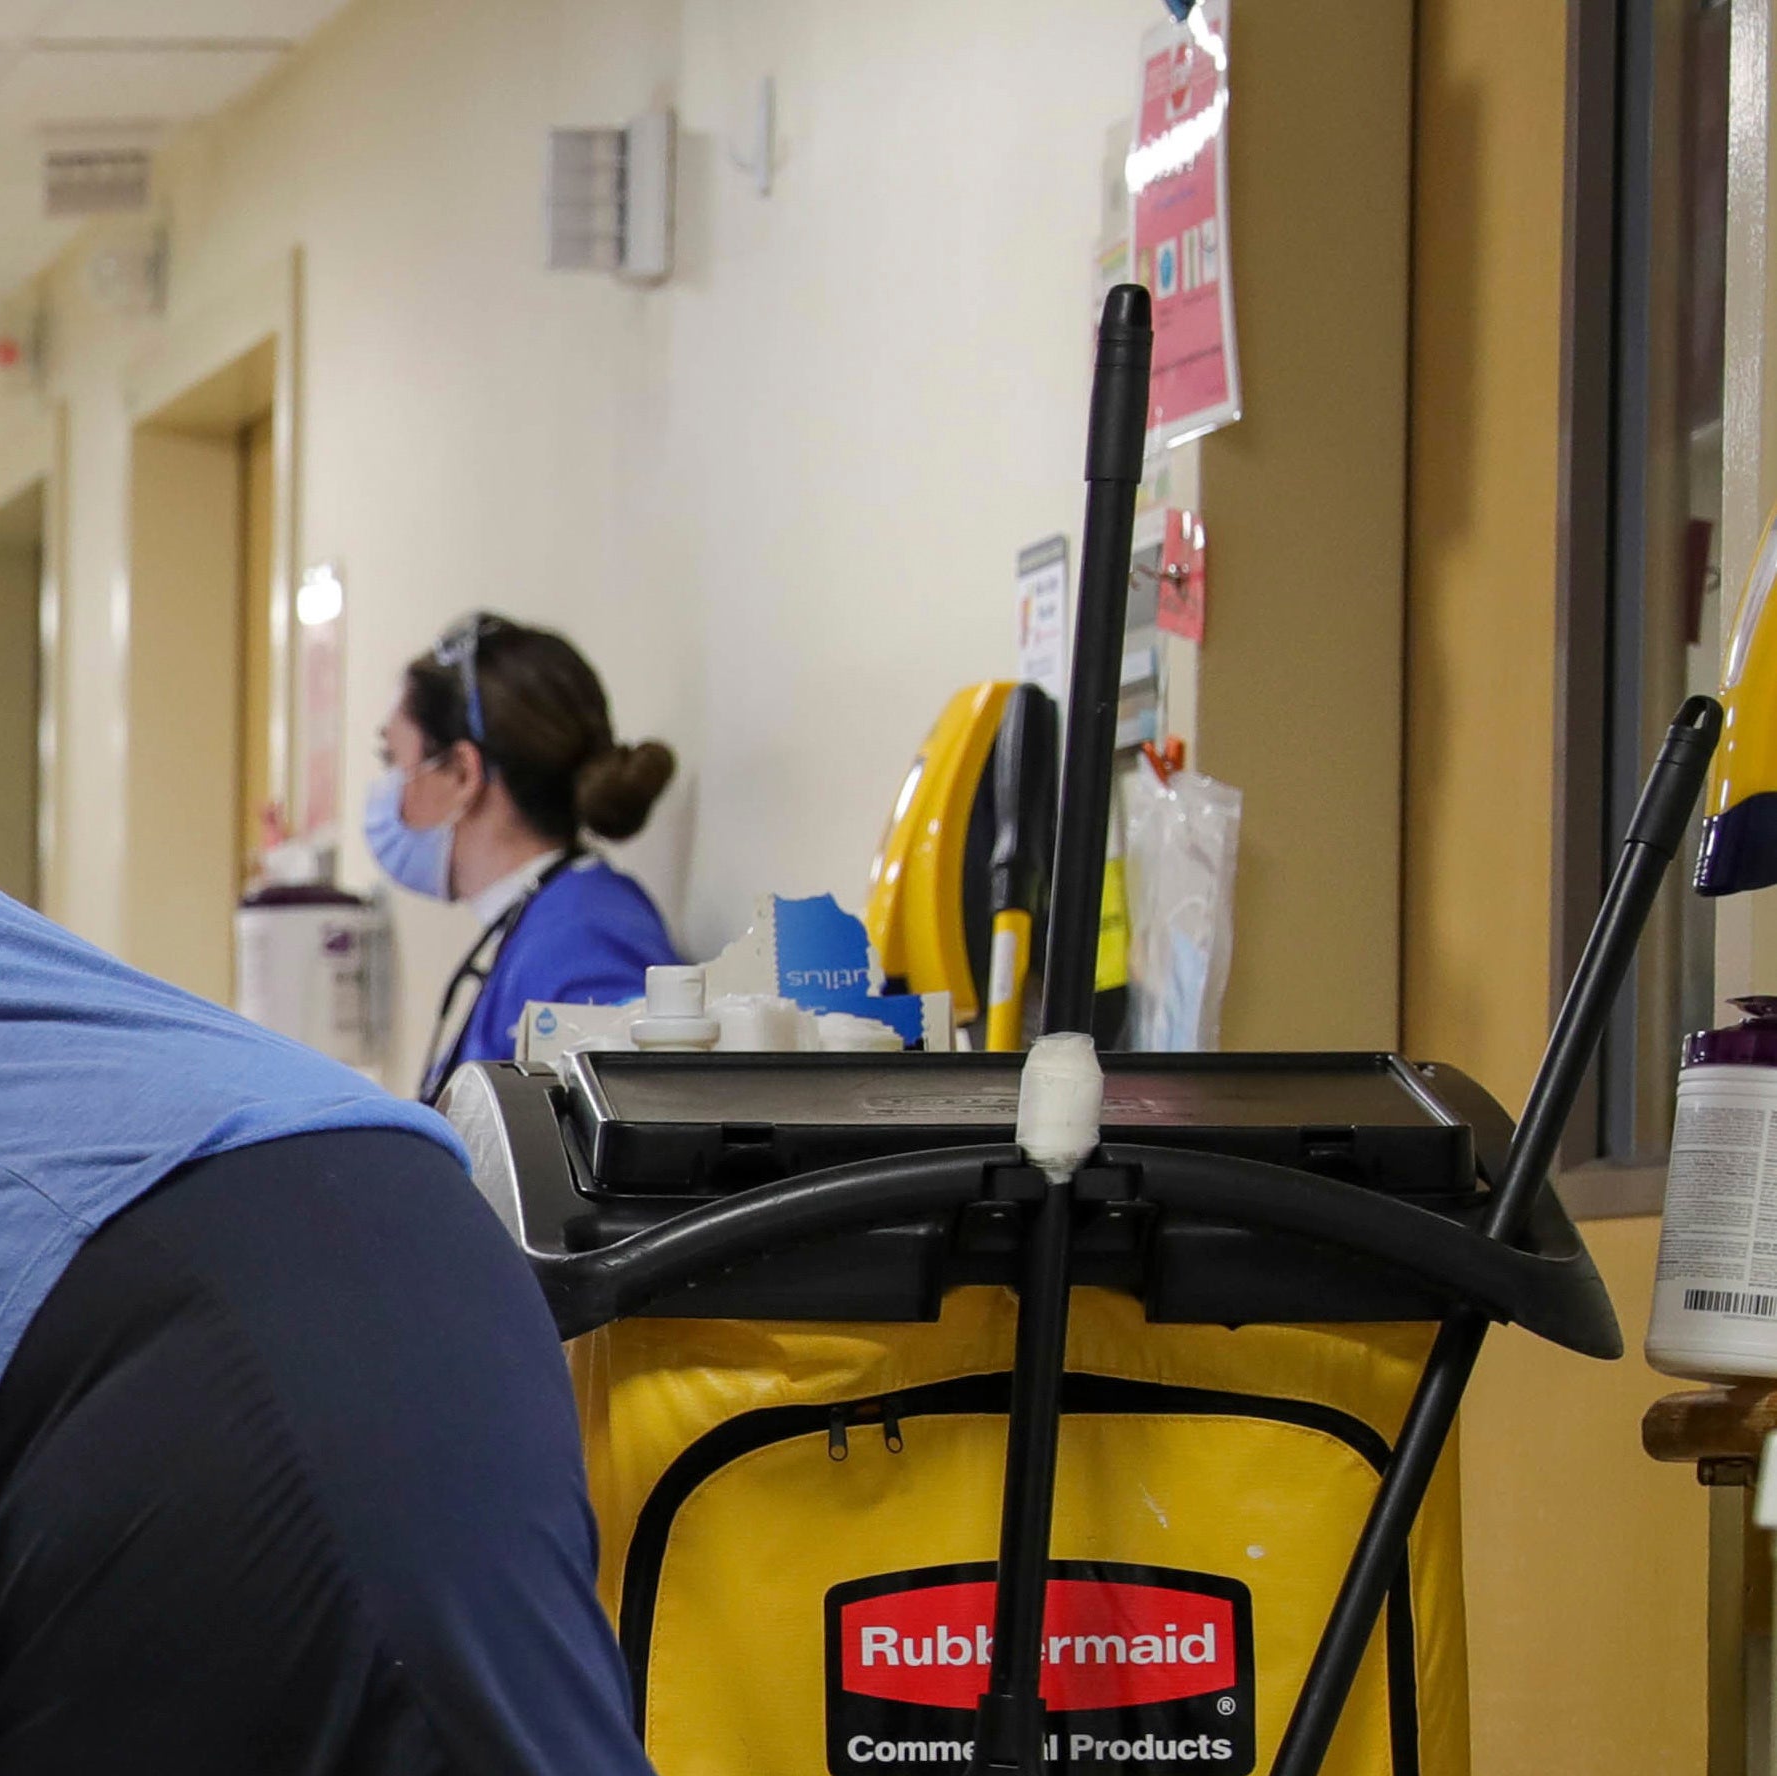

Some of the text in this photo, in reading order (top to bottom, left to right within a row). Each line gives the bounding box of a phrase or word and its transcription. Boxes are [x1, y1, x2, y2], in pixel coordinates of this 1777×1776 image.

[861, 1623, 1216, 1667] Rubbrmaid
[847, 1733, 1232, 1762] Commel Products
